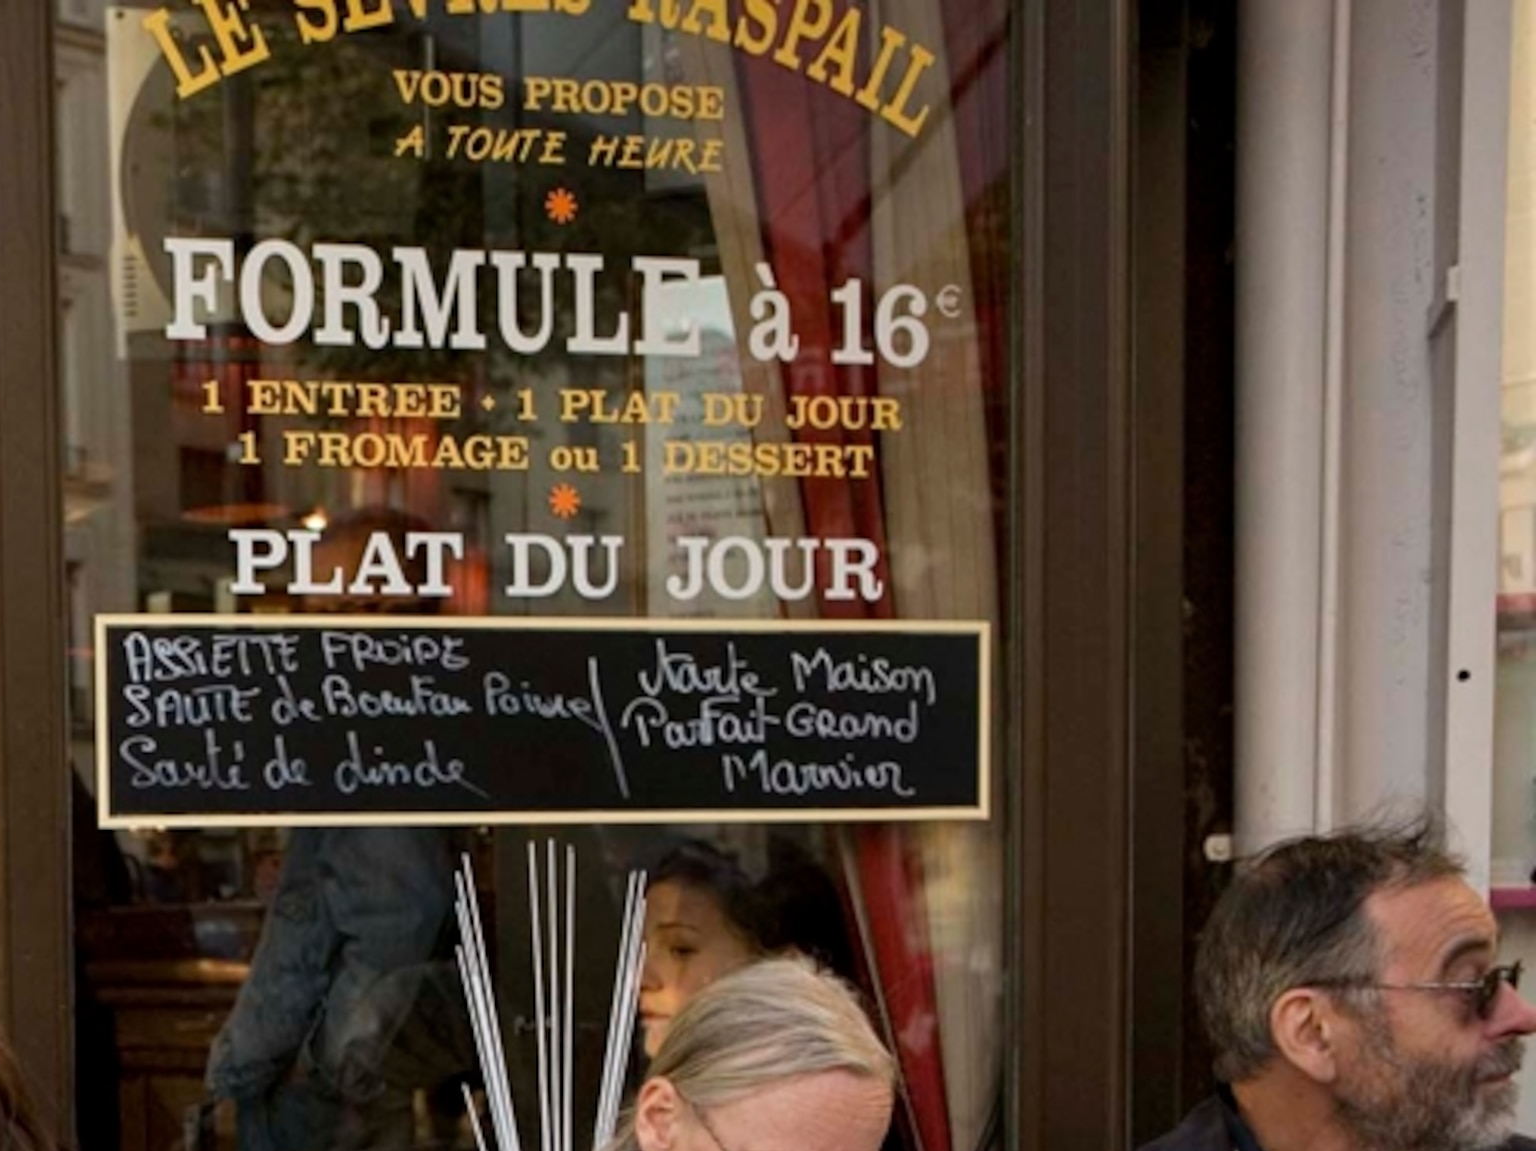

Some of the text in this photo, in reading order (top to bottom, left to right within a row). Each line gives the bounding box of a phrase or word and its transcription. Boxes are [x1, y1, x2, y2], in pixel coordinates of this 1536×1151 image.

[141, 0, 271, 99] LE
[393, 69, 725, 120] VOUS PROPOSE
[395, 125, 725, 174] A TOUTE HEURE
[163, 237, 701, 359] FORMULE
[748, 262, 800, 363] à
[201, 379, 224, 415] 1
[245, 379, 462, 420] ENTREE
[517, 387, 538, 421] 1
[559, 388, 681, 426] PLAT
[702, 391, 766, 430] DU
[785, 395, 904, 432] JOUR
[238, 430, 875, 479] 1 FROMAGE ou 1 DESSERT
[227, 528, 464, 597] PLAT
[505, 533, 624, 600] DU
[665, 535, 884, 602] JOUR
[269, 673, 323, 726] de
[790, 646, 937, 706] Maison
[261, 734, 313, 791] de
[334, 729, 490, 800] dinde
